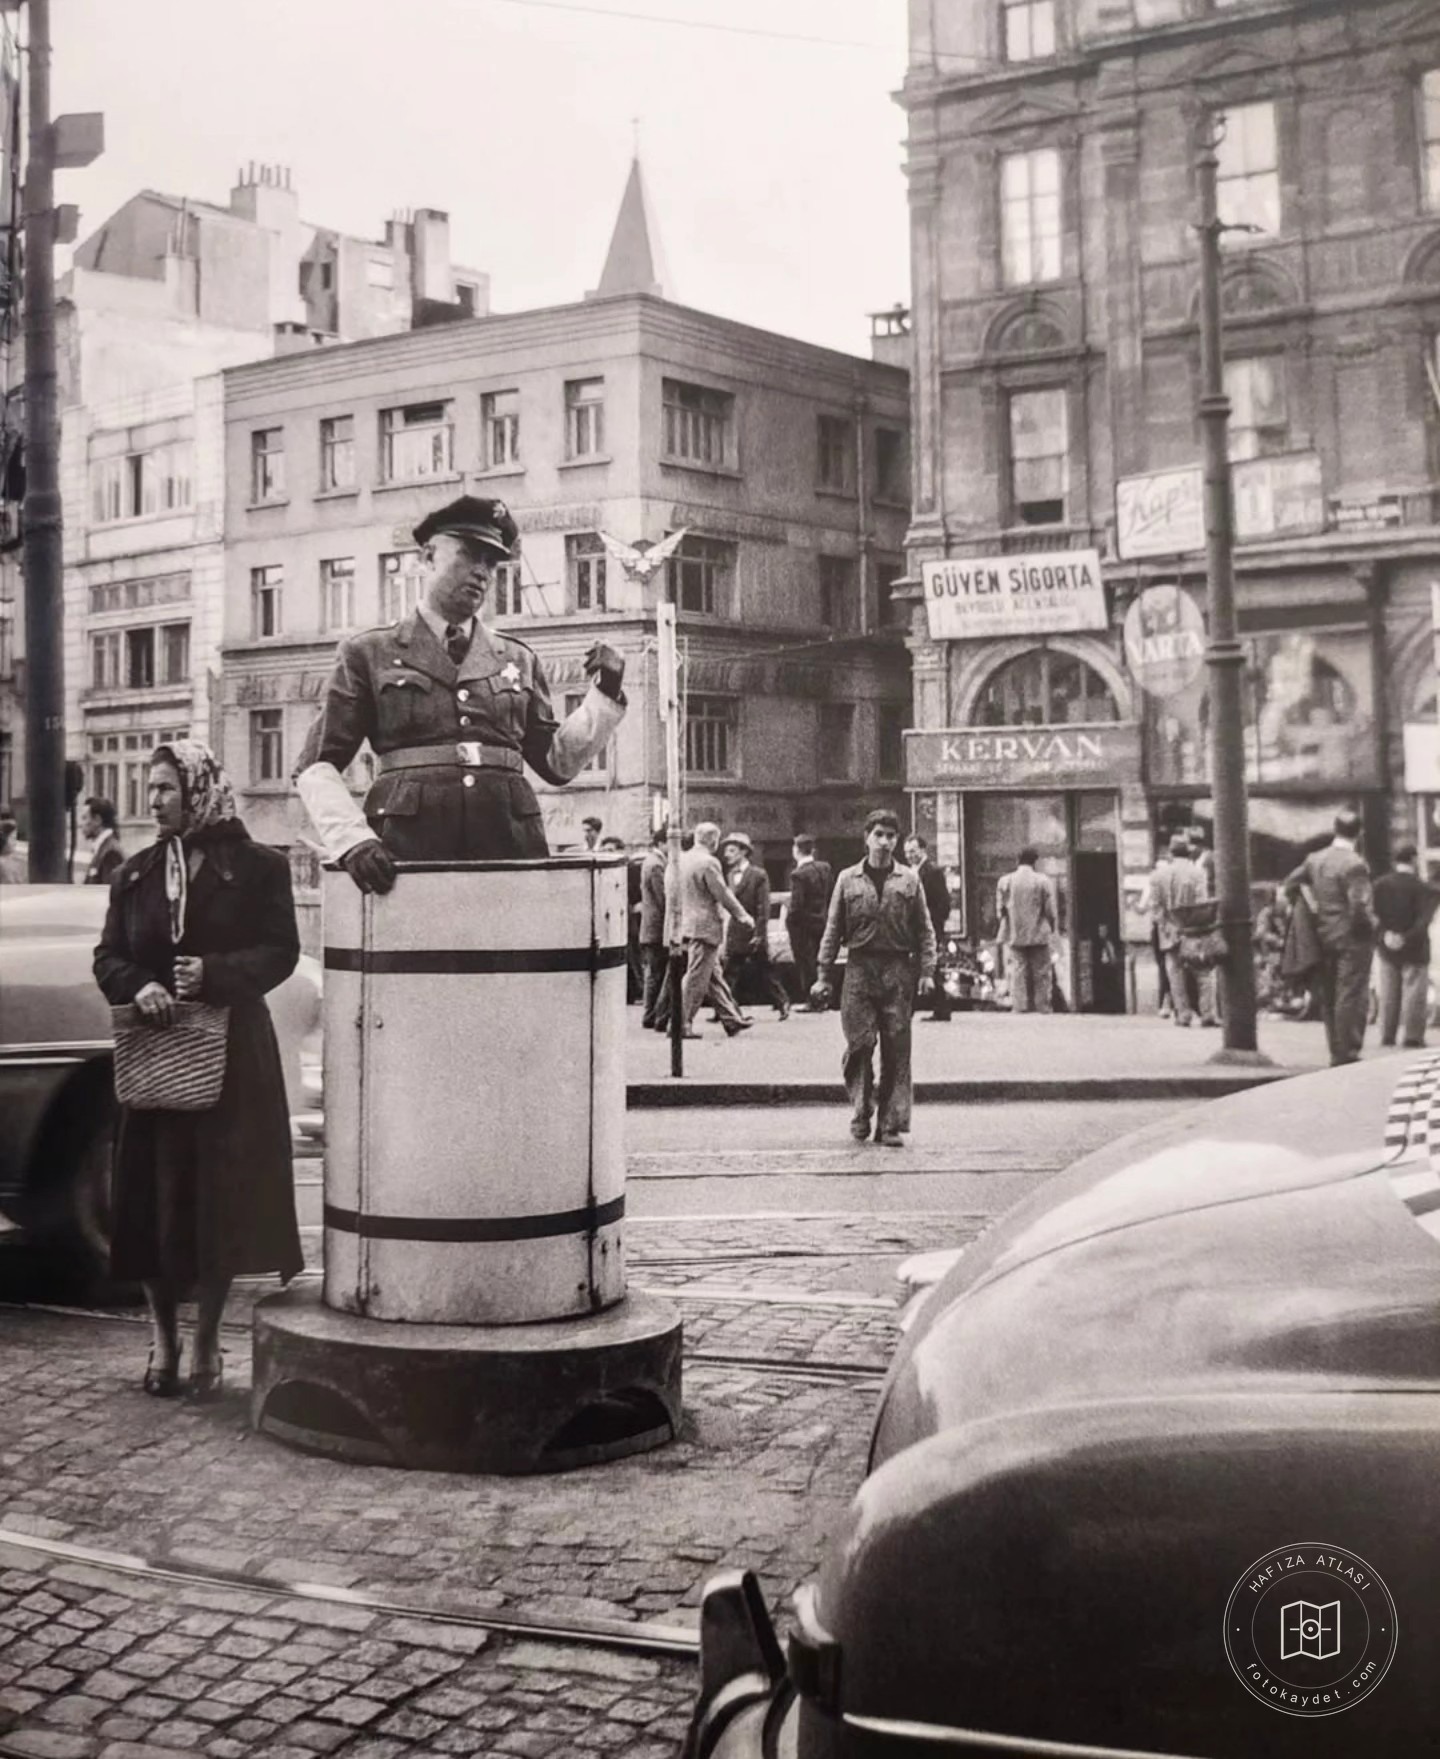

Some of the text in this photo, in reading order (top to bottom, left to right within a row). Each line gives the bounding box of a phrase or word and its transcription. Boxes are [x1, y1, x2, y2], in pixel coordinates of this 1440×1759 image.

[932, 562, 1093, 598] GÜVEN SİGORTA
[941, 734, 1102, 761] KERVAN
